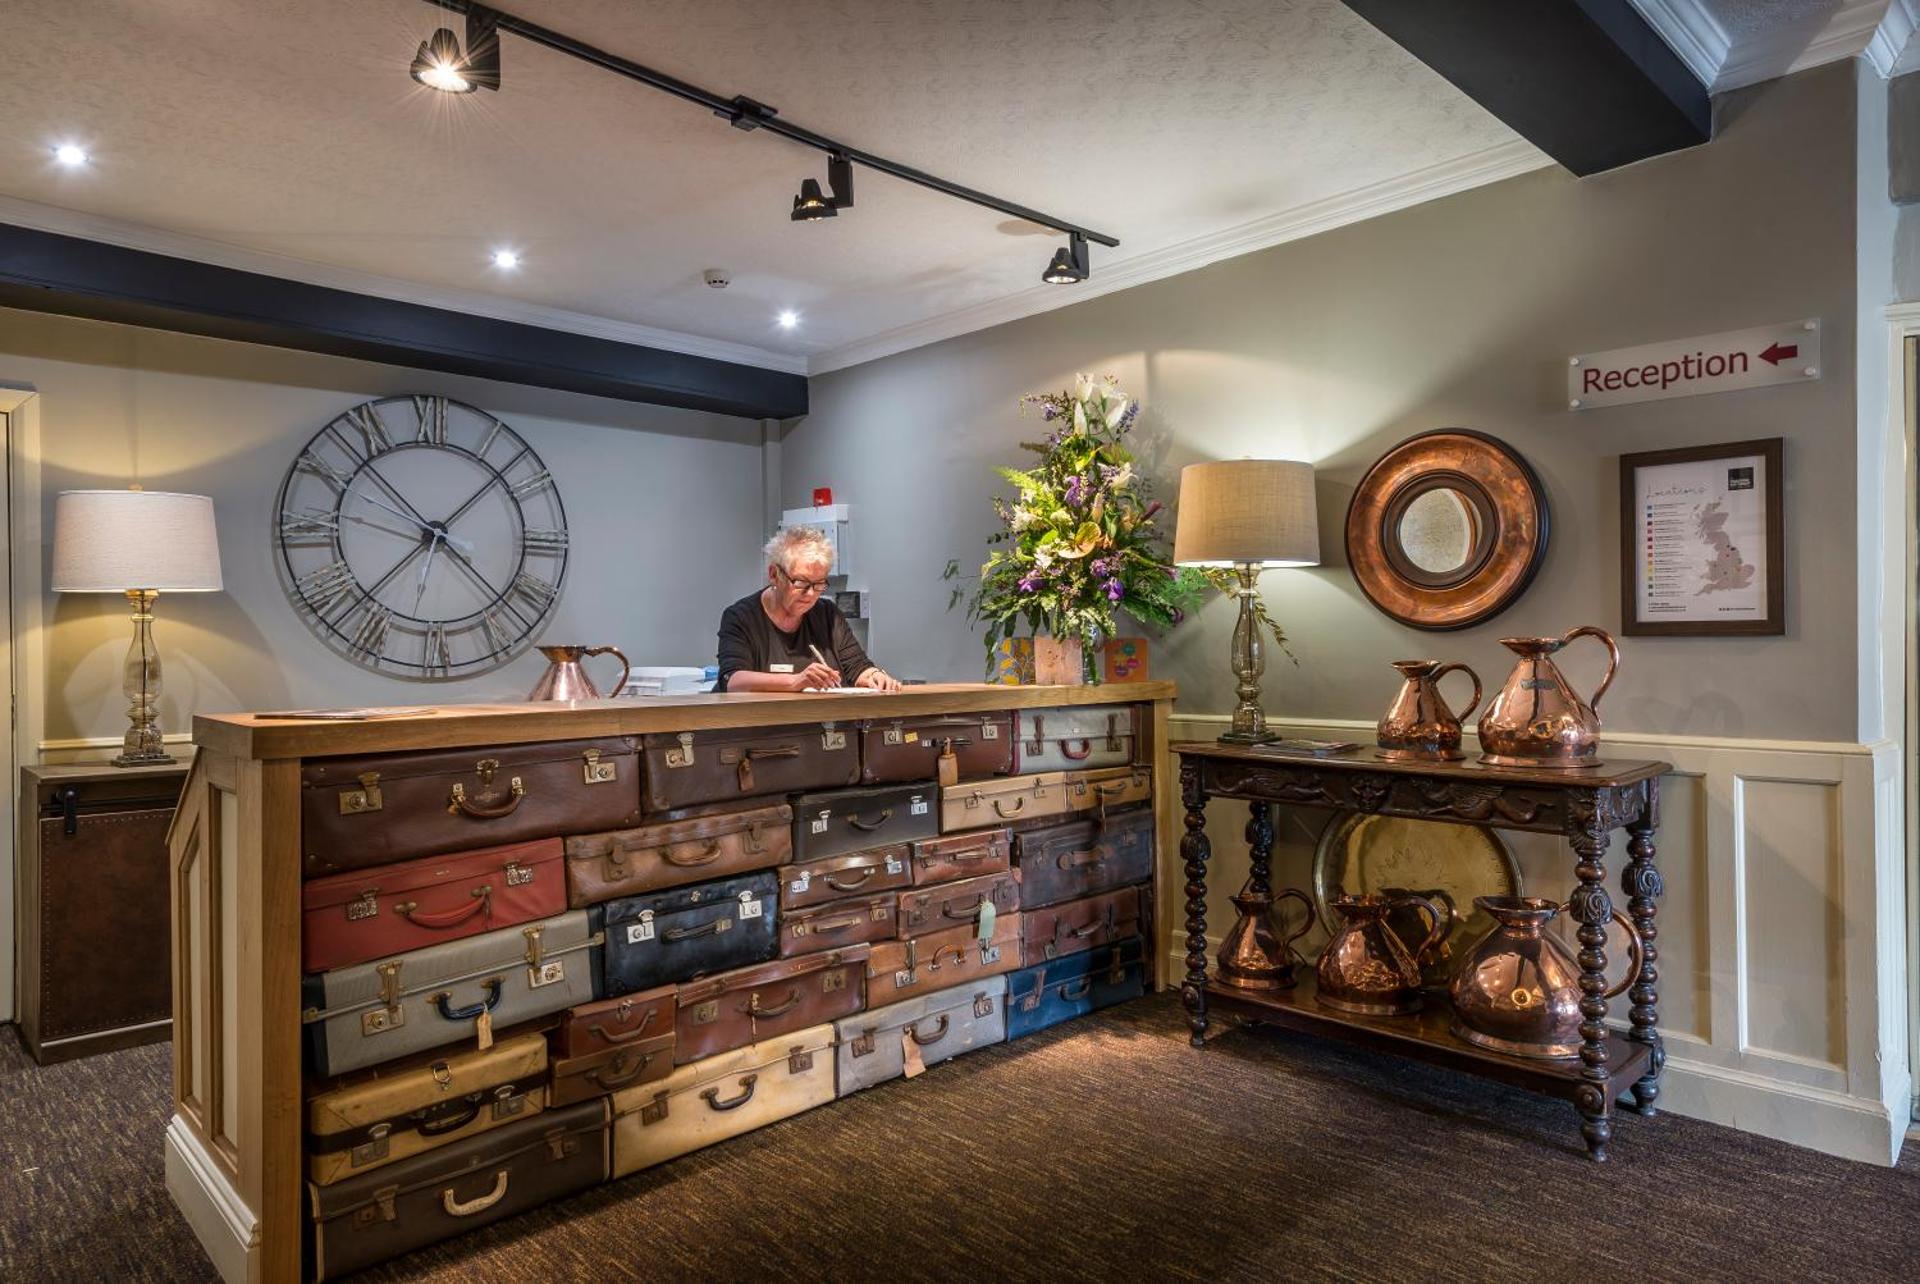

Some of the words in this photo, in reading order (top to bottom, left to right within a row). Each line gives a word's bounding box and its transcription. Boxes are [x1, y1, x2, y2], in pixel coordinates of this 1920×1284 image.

[1583, 350, 1749, 394] Reception
[345, 401, 395, 457] XI
[413, 395, 449, 445] XII
